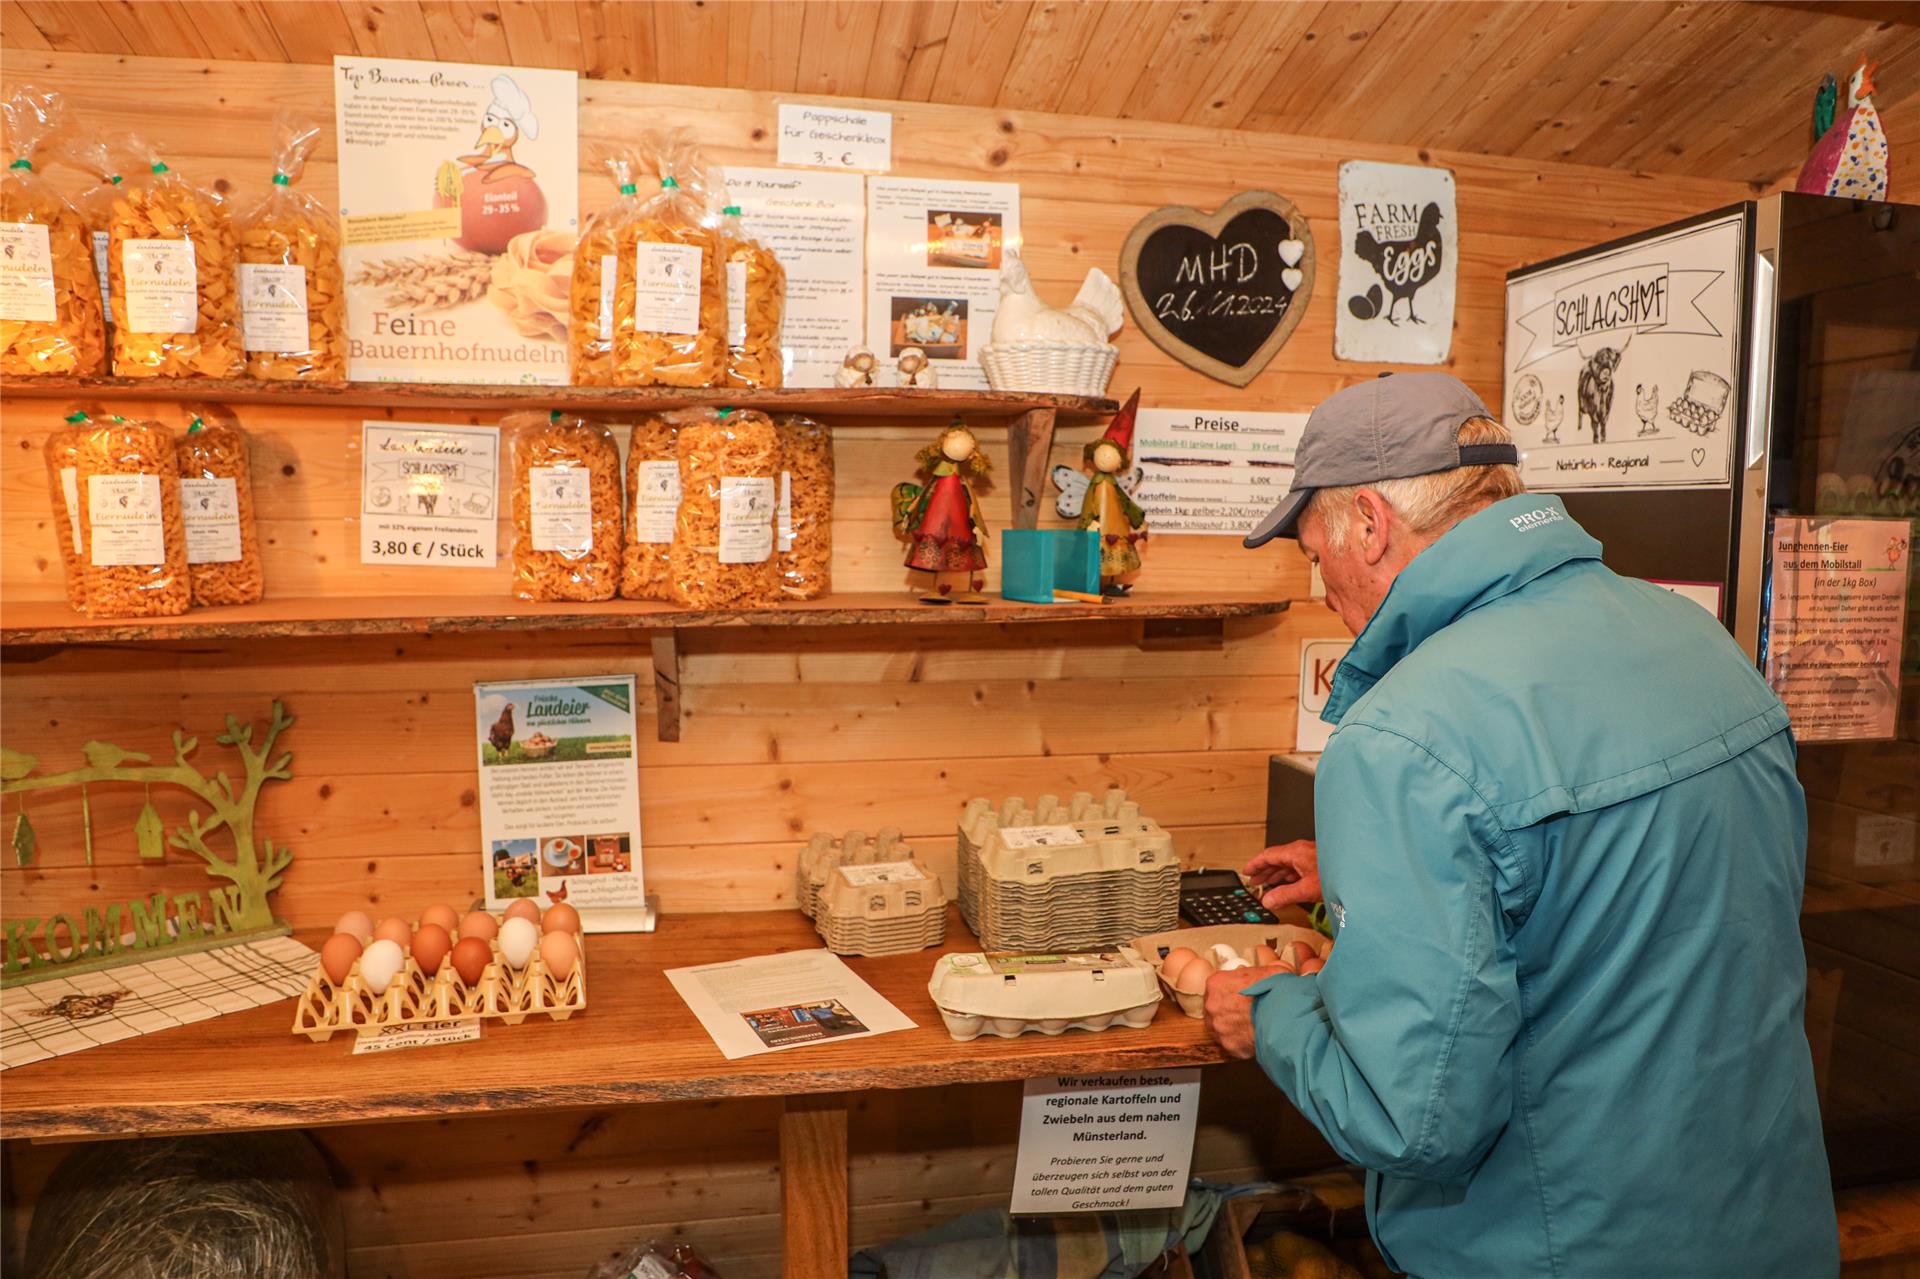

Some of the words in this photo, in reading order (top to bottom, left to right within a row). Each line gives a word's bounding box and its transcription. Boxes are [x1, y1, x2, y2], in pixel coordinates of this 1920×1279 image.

[841, 152, 855, 165] €
[1354, 203, 1419, 229] FARM
[1376, 224, 1416, 241] FRESH
[1175, 242, 1258, 285] MHD
[1383, 240, 1436, 286] Eggs
[373, 312, 456, 336] Feine
[350, 340, 566, 364] Bauernhofnudeln
[1194, 416, 1240, 432] Preise
[1556, 458, 1598, 471] Natürlich
[1607, 456, 1649, 474] Regional
[1509, 506, 1560, 529] PRO-X
[1519, 514, 1564, 532] elements
[372, 540, 407, 556] 3,80
[412, 542, 422, 556] €
[440, 543, 485, 558] Stück
[1778, 541, 1849, 552] Junghennen-Eier
[1783, 560, 1799, 569] aus
[1800, 559, 1819, 569] dem
[1821, 559, 1862, 569] Mobilstall
[1827, 577, 1840, 587] der
[1842, 577, 1857, 588] 1kg
[1859, 577, 1877, 588] Box)
[1313, 658, 1337, 696] K
[525, 698, 591, 718] Landeier
[386, 1039, 418, 1049] Cent
[1058, 1076, 1079, 1087] Wir
[1081, 1075, 1137, 1087] verkaufen
[1139, 1075, 1174, 1087] beste,
[1046, 1095, 1098, 1108] regionale
[1101, 1093, 1157, 1105] Kartoffeln
[1160, 1093, 1181, 1104] und
[1043, 1113, 1094, 1125] Zwiebeln
[1097, 1114, 1116, 1123] aus
[1119, 1112, 1143, 1123] dem
[1146, 1112, 1180, 1122] nahen
[1073, 1130, 1147, 1142] Münsterland.
[1050, 1155, 1097, 1166] Probieren
[1099, 1155, 1113, 1165] Sie
[1115, 1156, 1143, 1166] gerne
[1145, 1153, 1164, 1163] und
[1032, 1171, 1089, 1182] überzeugen
[1091, 1169, 1110, 1180] sich
[1111, 1169, 1139, 1179] selbst
[1141, 1169, 1158, 1178] von
[1160, 1168, 1177, 1177] der
[1031, 1186, 1058, 1196] tollen
[1061, 1185, 1100, 1196] Qualität
[1102, 1185, 1120, 1194] und
[1122, 1184, 1143, 1194] dem
[1145, 1183, 1173, 1194] guten
[1071, 1199, 1130, 1210] Geschmack!
